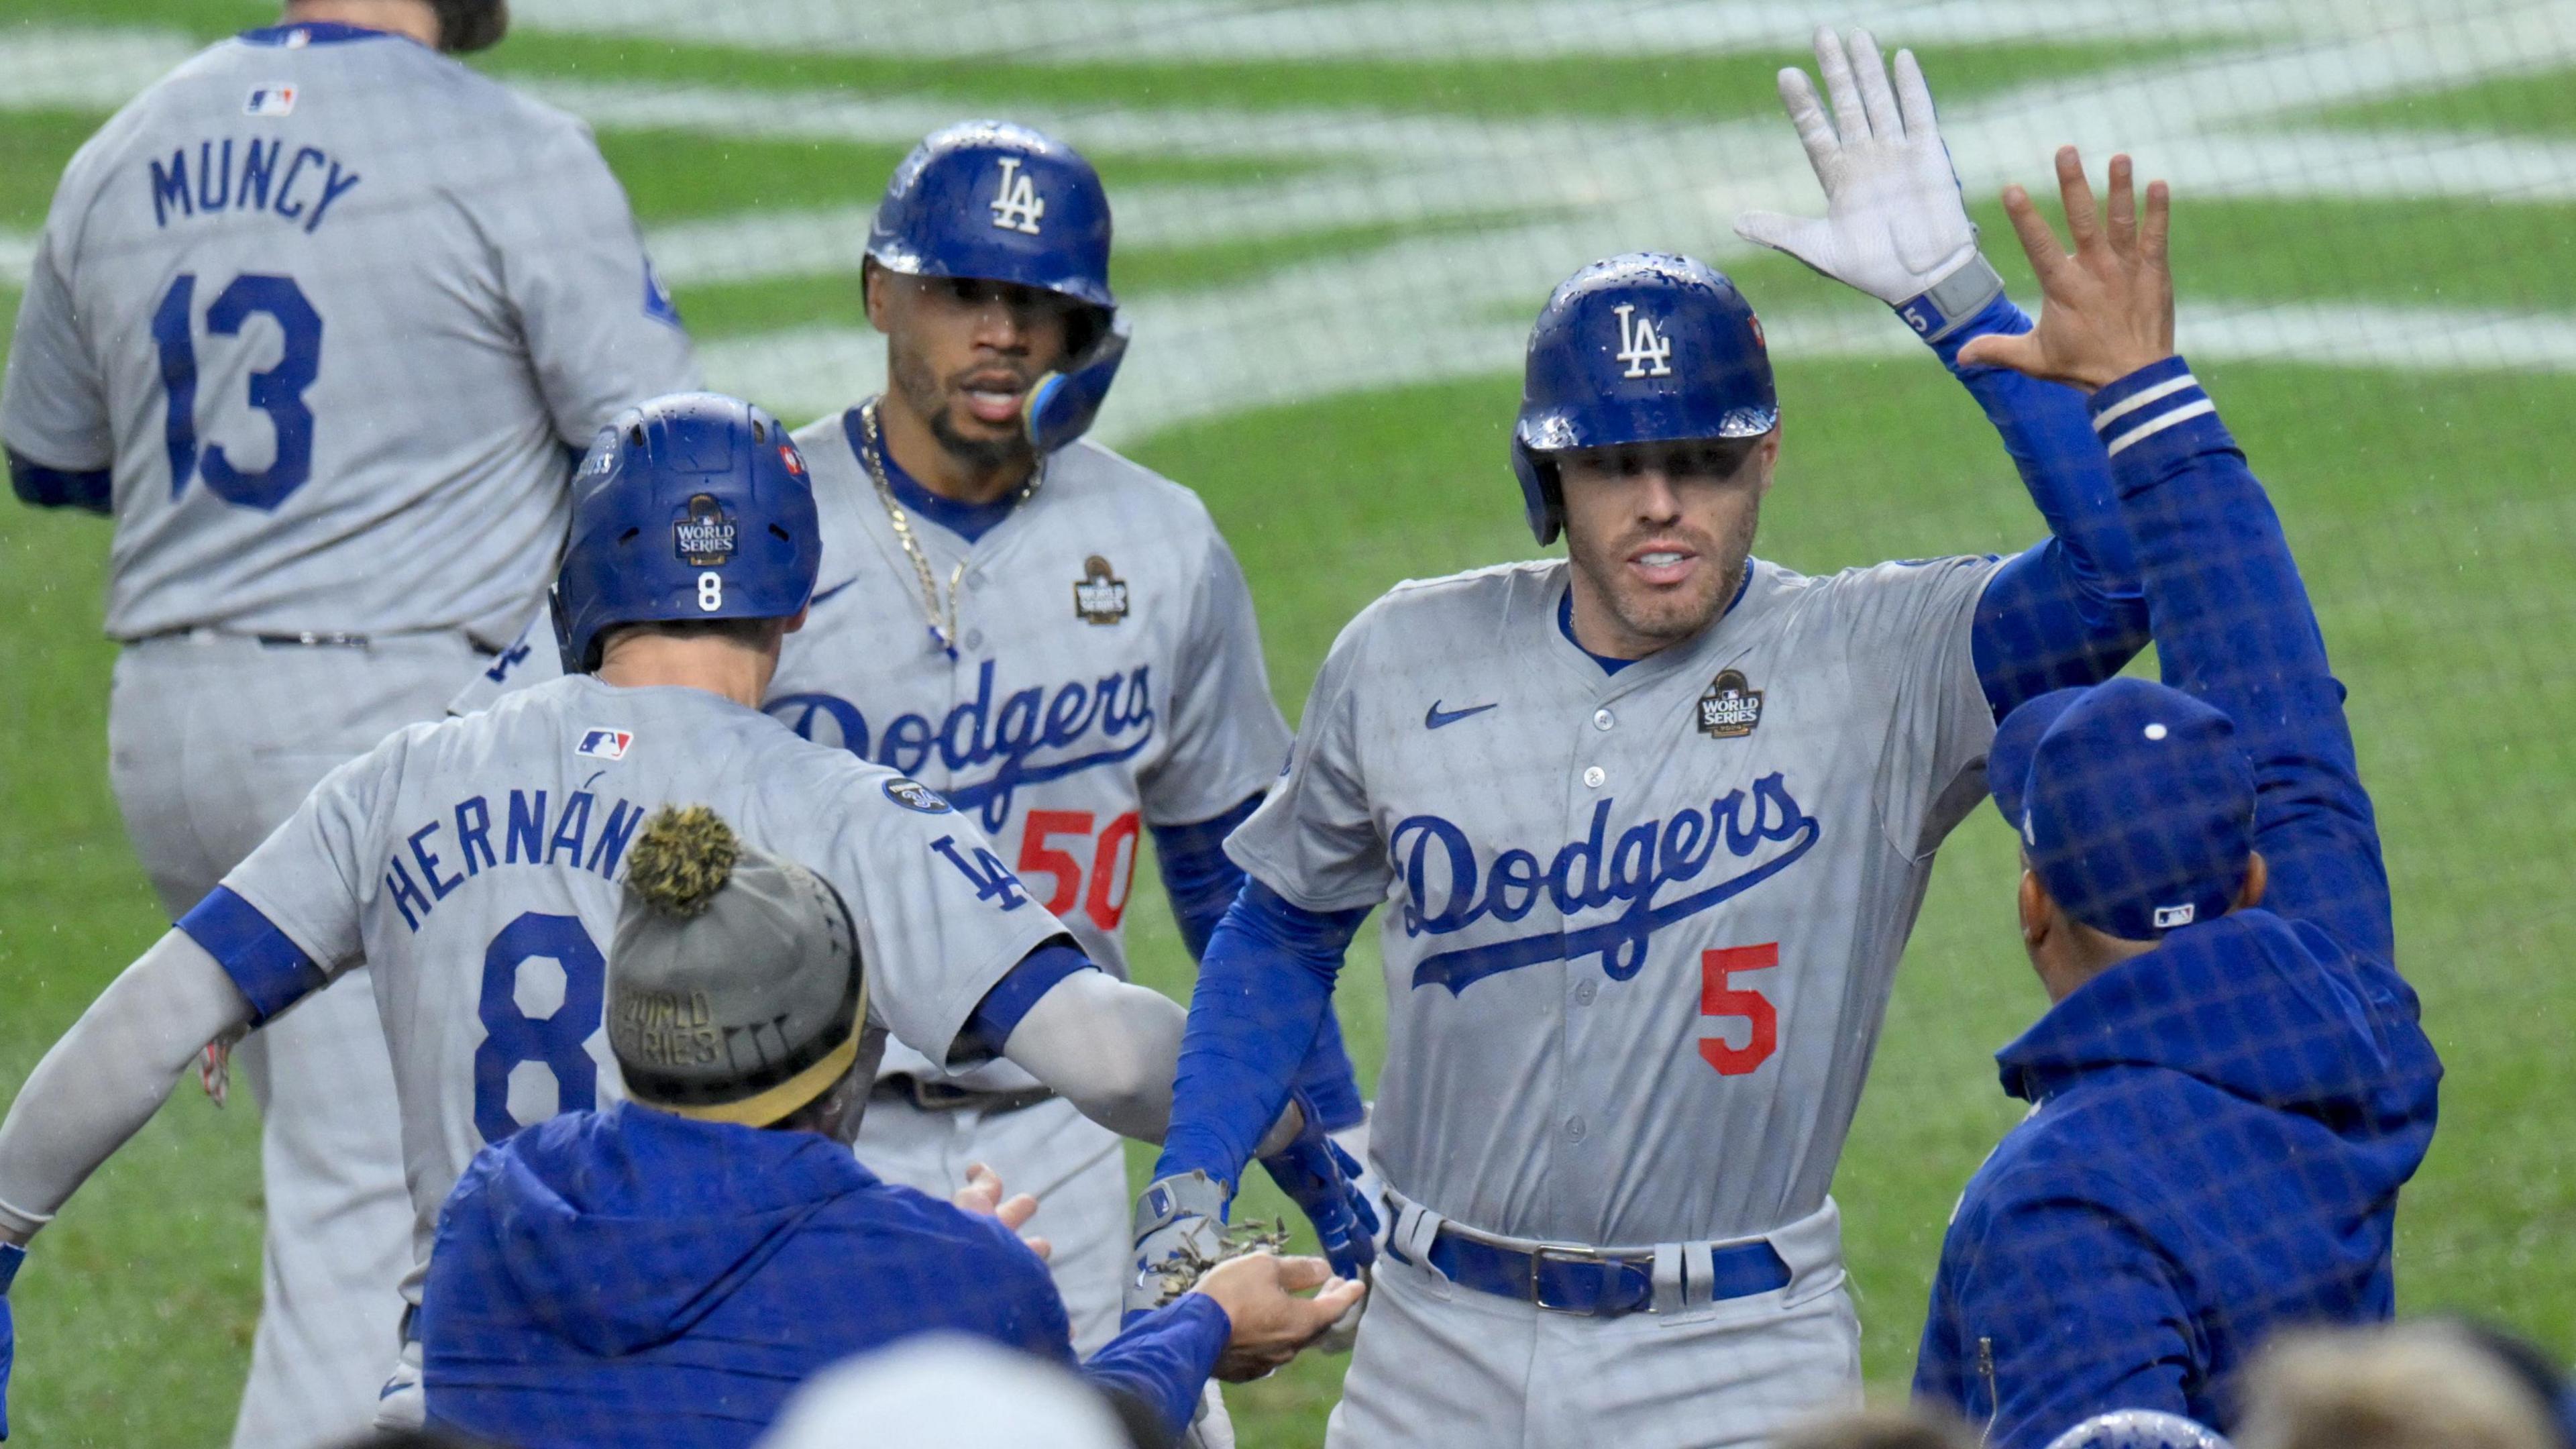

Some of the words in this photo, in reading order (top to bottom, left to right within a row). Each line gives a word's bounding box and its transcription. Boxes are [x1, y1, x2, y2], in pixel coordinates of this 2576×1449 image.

[150, 138, 361, 233] MUNCY
[990, 156, 1044, 235] LA
[1613, 305, 1671, 378] LA
[1903, 307, 1928, 332] 5
[152, 274, 323, 513] 13
[677, 525, 735, 539] WORLD
[680, 538, 734, 553] SERIES
[698, 572, 722, 612] 8
[1702, 697, 1759, 714] WORLD
[1705, 709, 1758, 725] SERIES
[760, 658, 1155, 835] Dodgers
[386, 770, 645, 934] HERNÁN
[929, 835, 1029, 912] LA
[1016, 809, 1141, 931] 50
[1391, 771, 1821, 998] Dodgers
[474, 910, 607, 1144] 8
[1698, 941, 1780, 1076] 5
